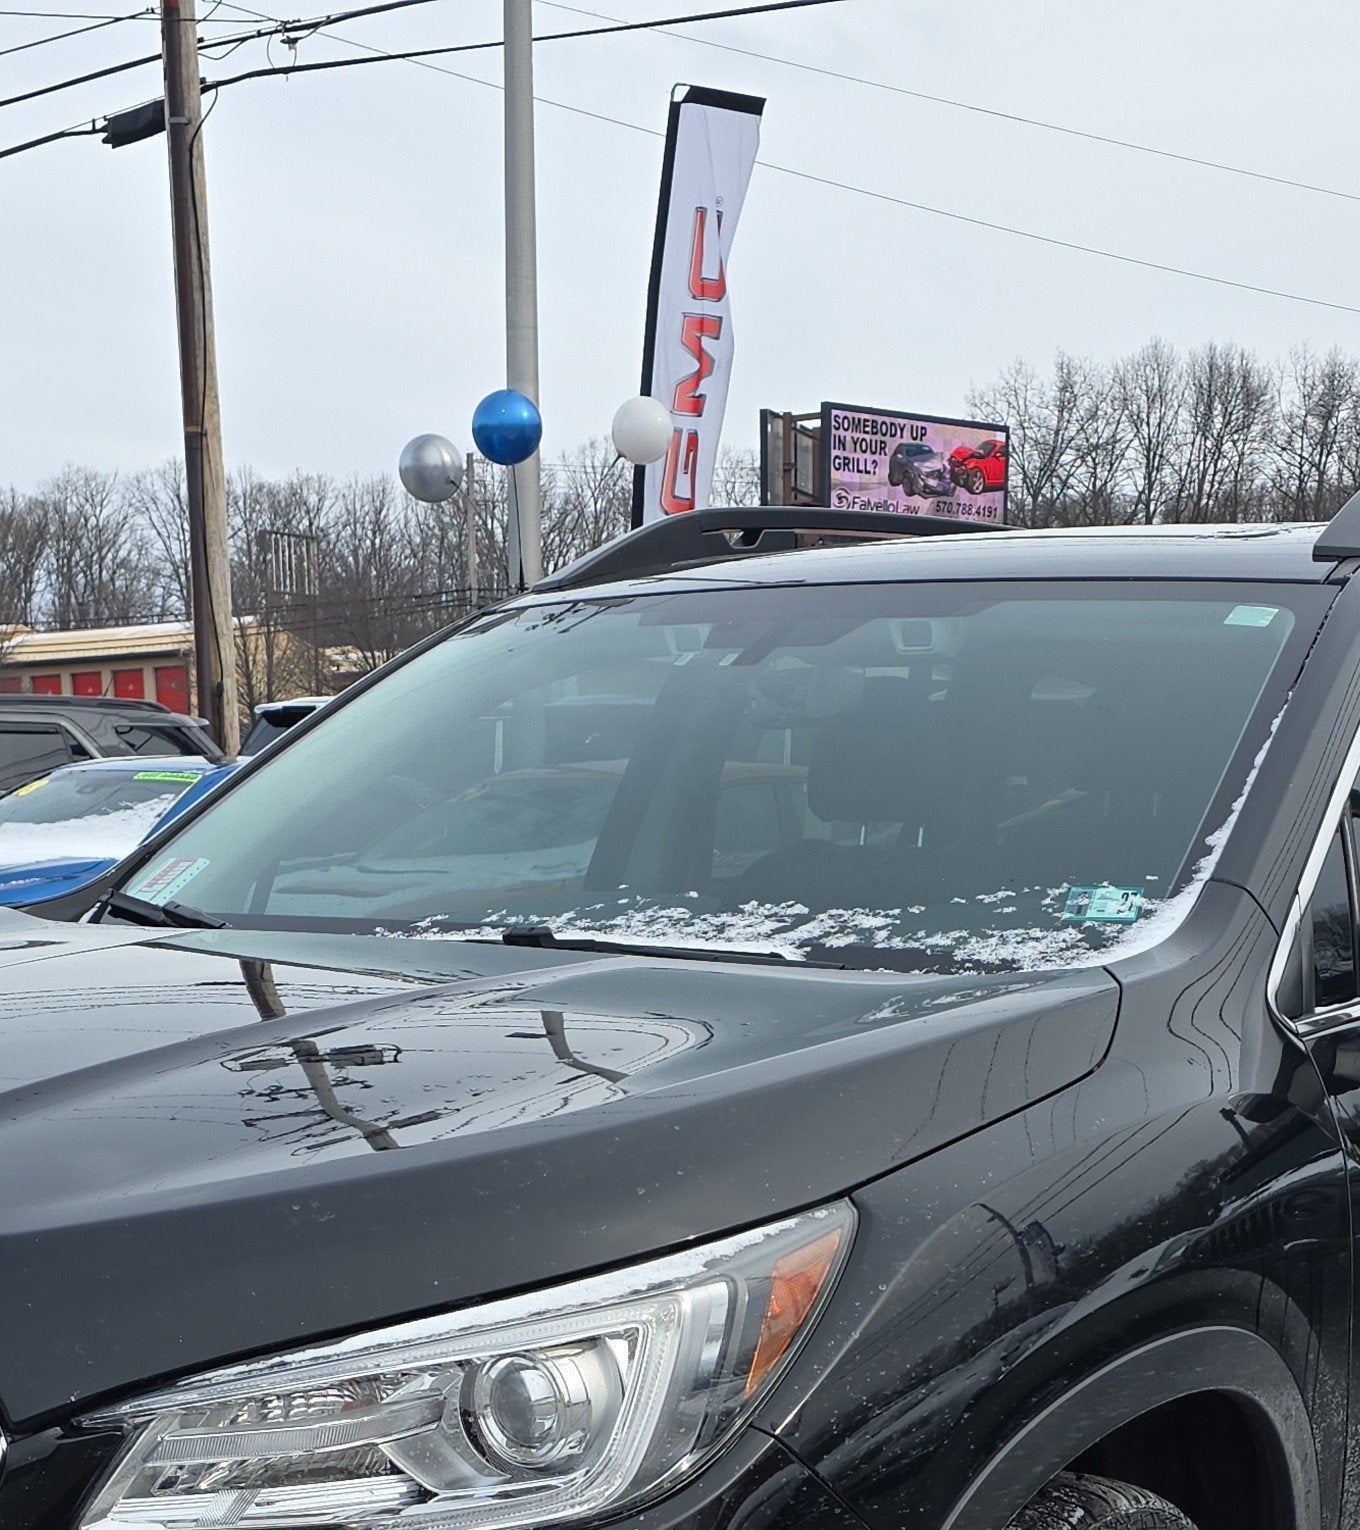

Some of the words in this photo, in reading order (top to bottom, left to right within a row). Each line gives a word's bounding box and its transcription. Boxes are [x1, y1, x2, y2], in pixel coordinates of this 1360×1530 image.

[660, 206, 727, 516] GMC
[832, 413, 907, 439] SOMEBODY
[910, 419, 928, 442] UP
[832, 433, 847, 452] IN
[851, 436, 888, 457] YOUR
[832, 455, 879, 476] GRILL?
[935, 500, 998, 519] 570.788.4191
